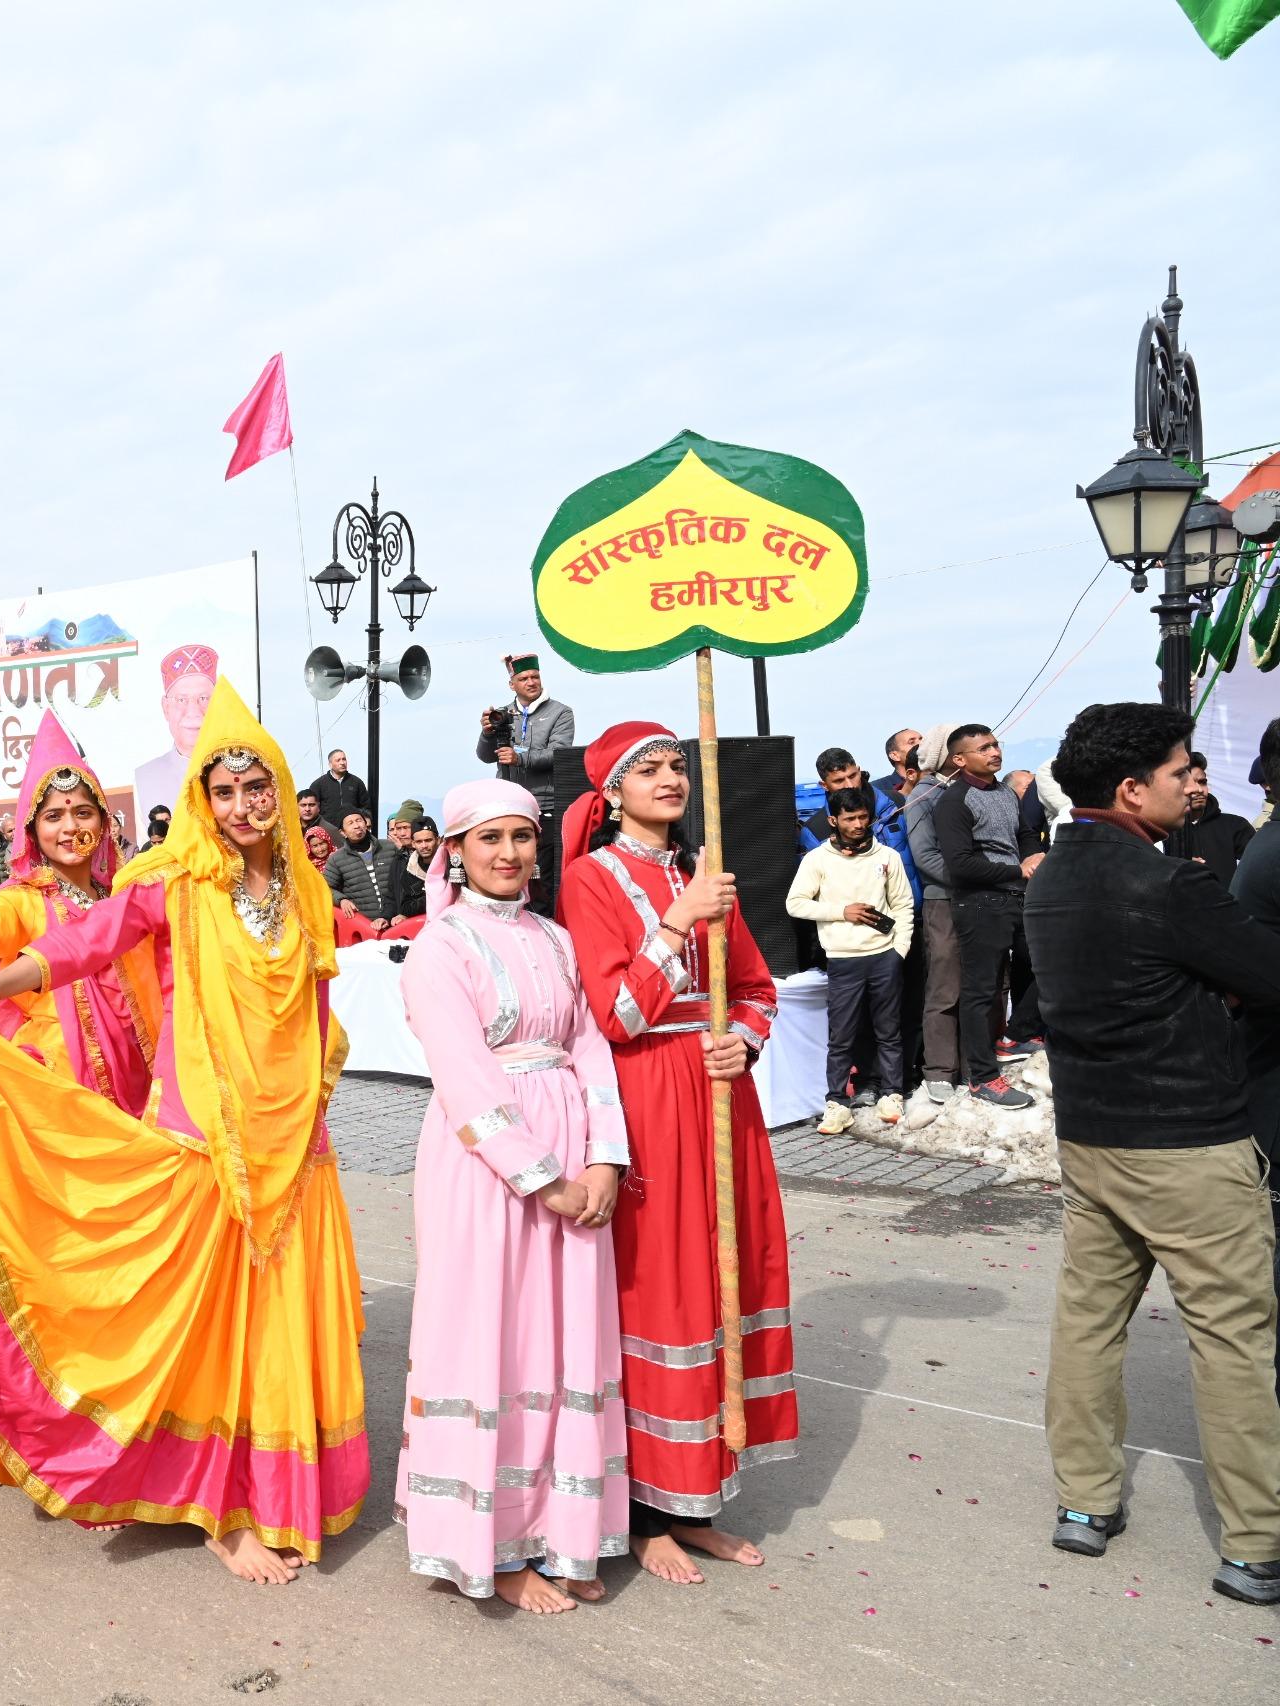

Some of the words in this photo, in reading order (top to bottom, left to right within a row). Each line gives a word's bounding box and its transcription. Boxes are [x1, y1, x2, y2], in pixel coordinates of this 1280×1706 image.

[561, 508, 750, 585] सांस्कृतिक
[762, 524, 831, 571] दल
[650, 571, 796, 611] हमीरपुर
